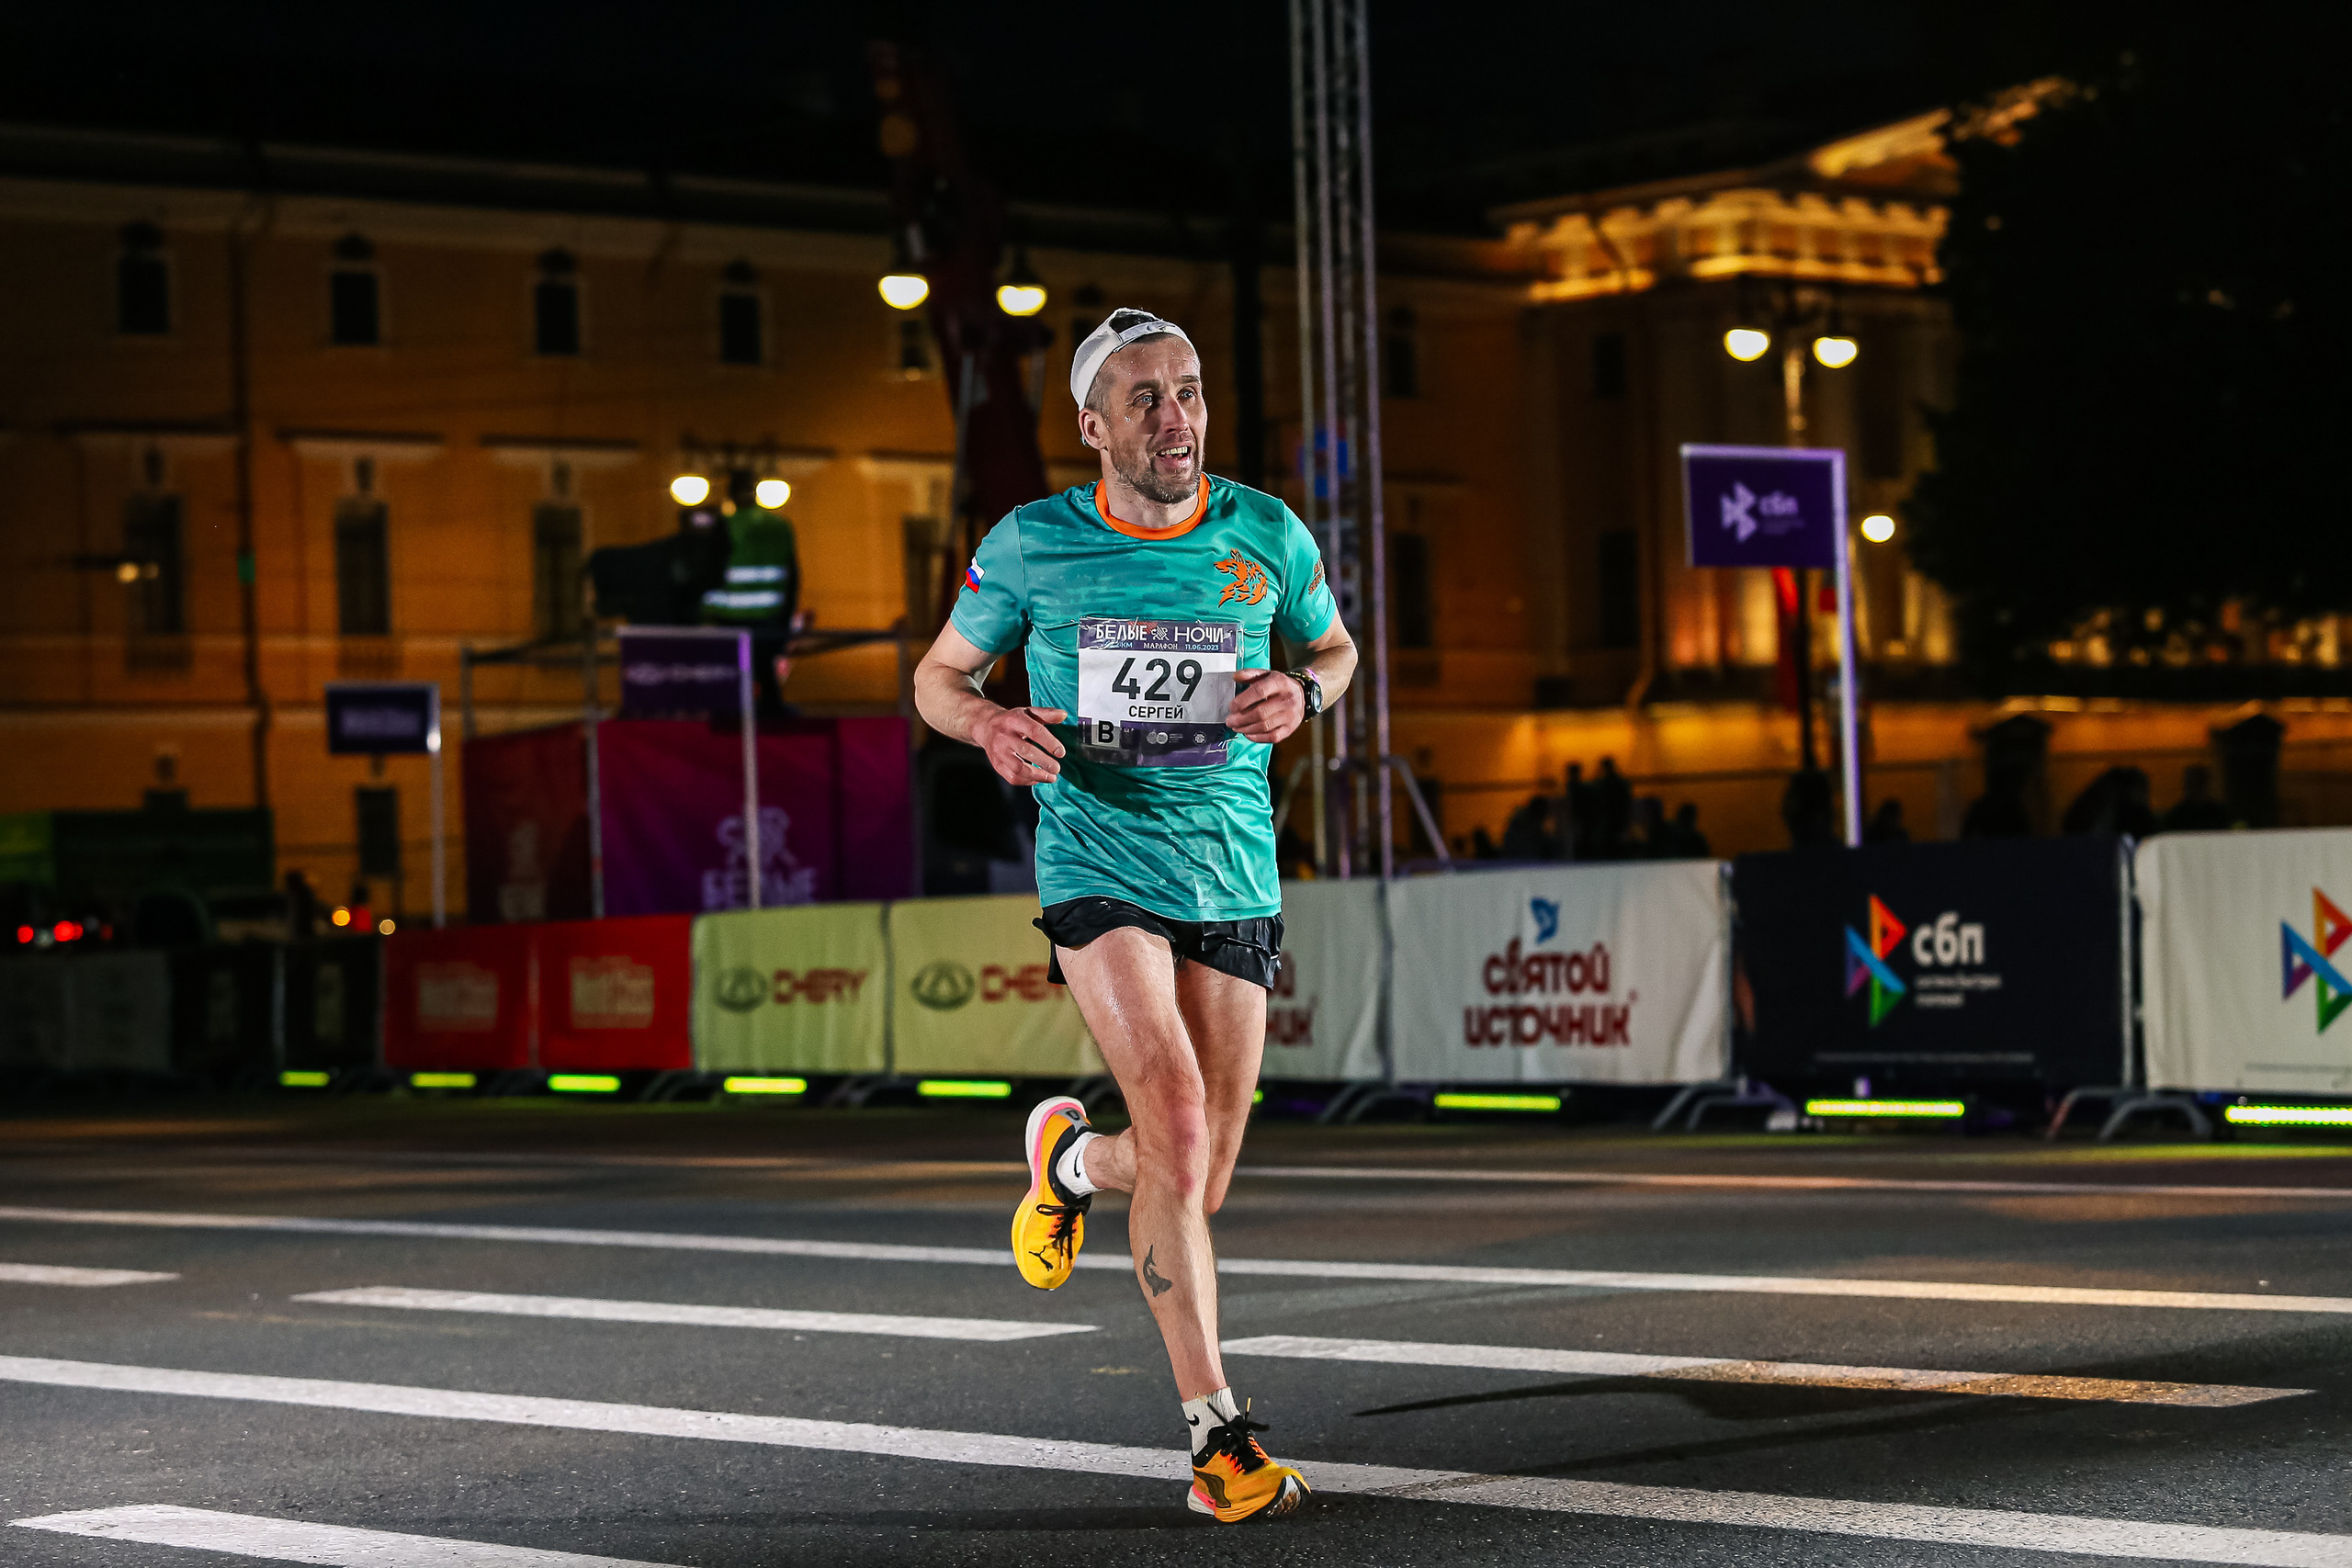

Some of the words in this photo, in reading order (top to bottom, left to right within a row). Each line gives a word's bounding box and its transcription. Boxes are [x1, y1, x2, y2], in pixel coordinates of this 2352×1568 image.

[1096, 624, 1148, 641] БЕЛЫЕ
[1175, 626, 1224, 643] НОЧИ
[1143, 642, 1178, 650] МАРАФОН
[1112, 657, 1203, 702] 429
[1128, 705, 1183, 719] СЕРГЕЙ
[775, 967, 868, 1005] CHERY
[981, 964, 1065, 1002] CHE
